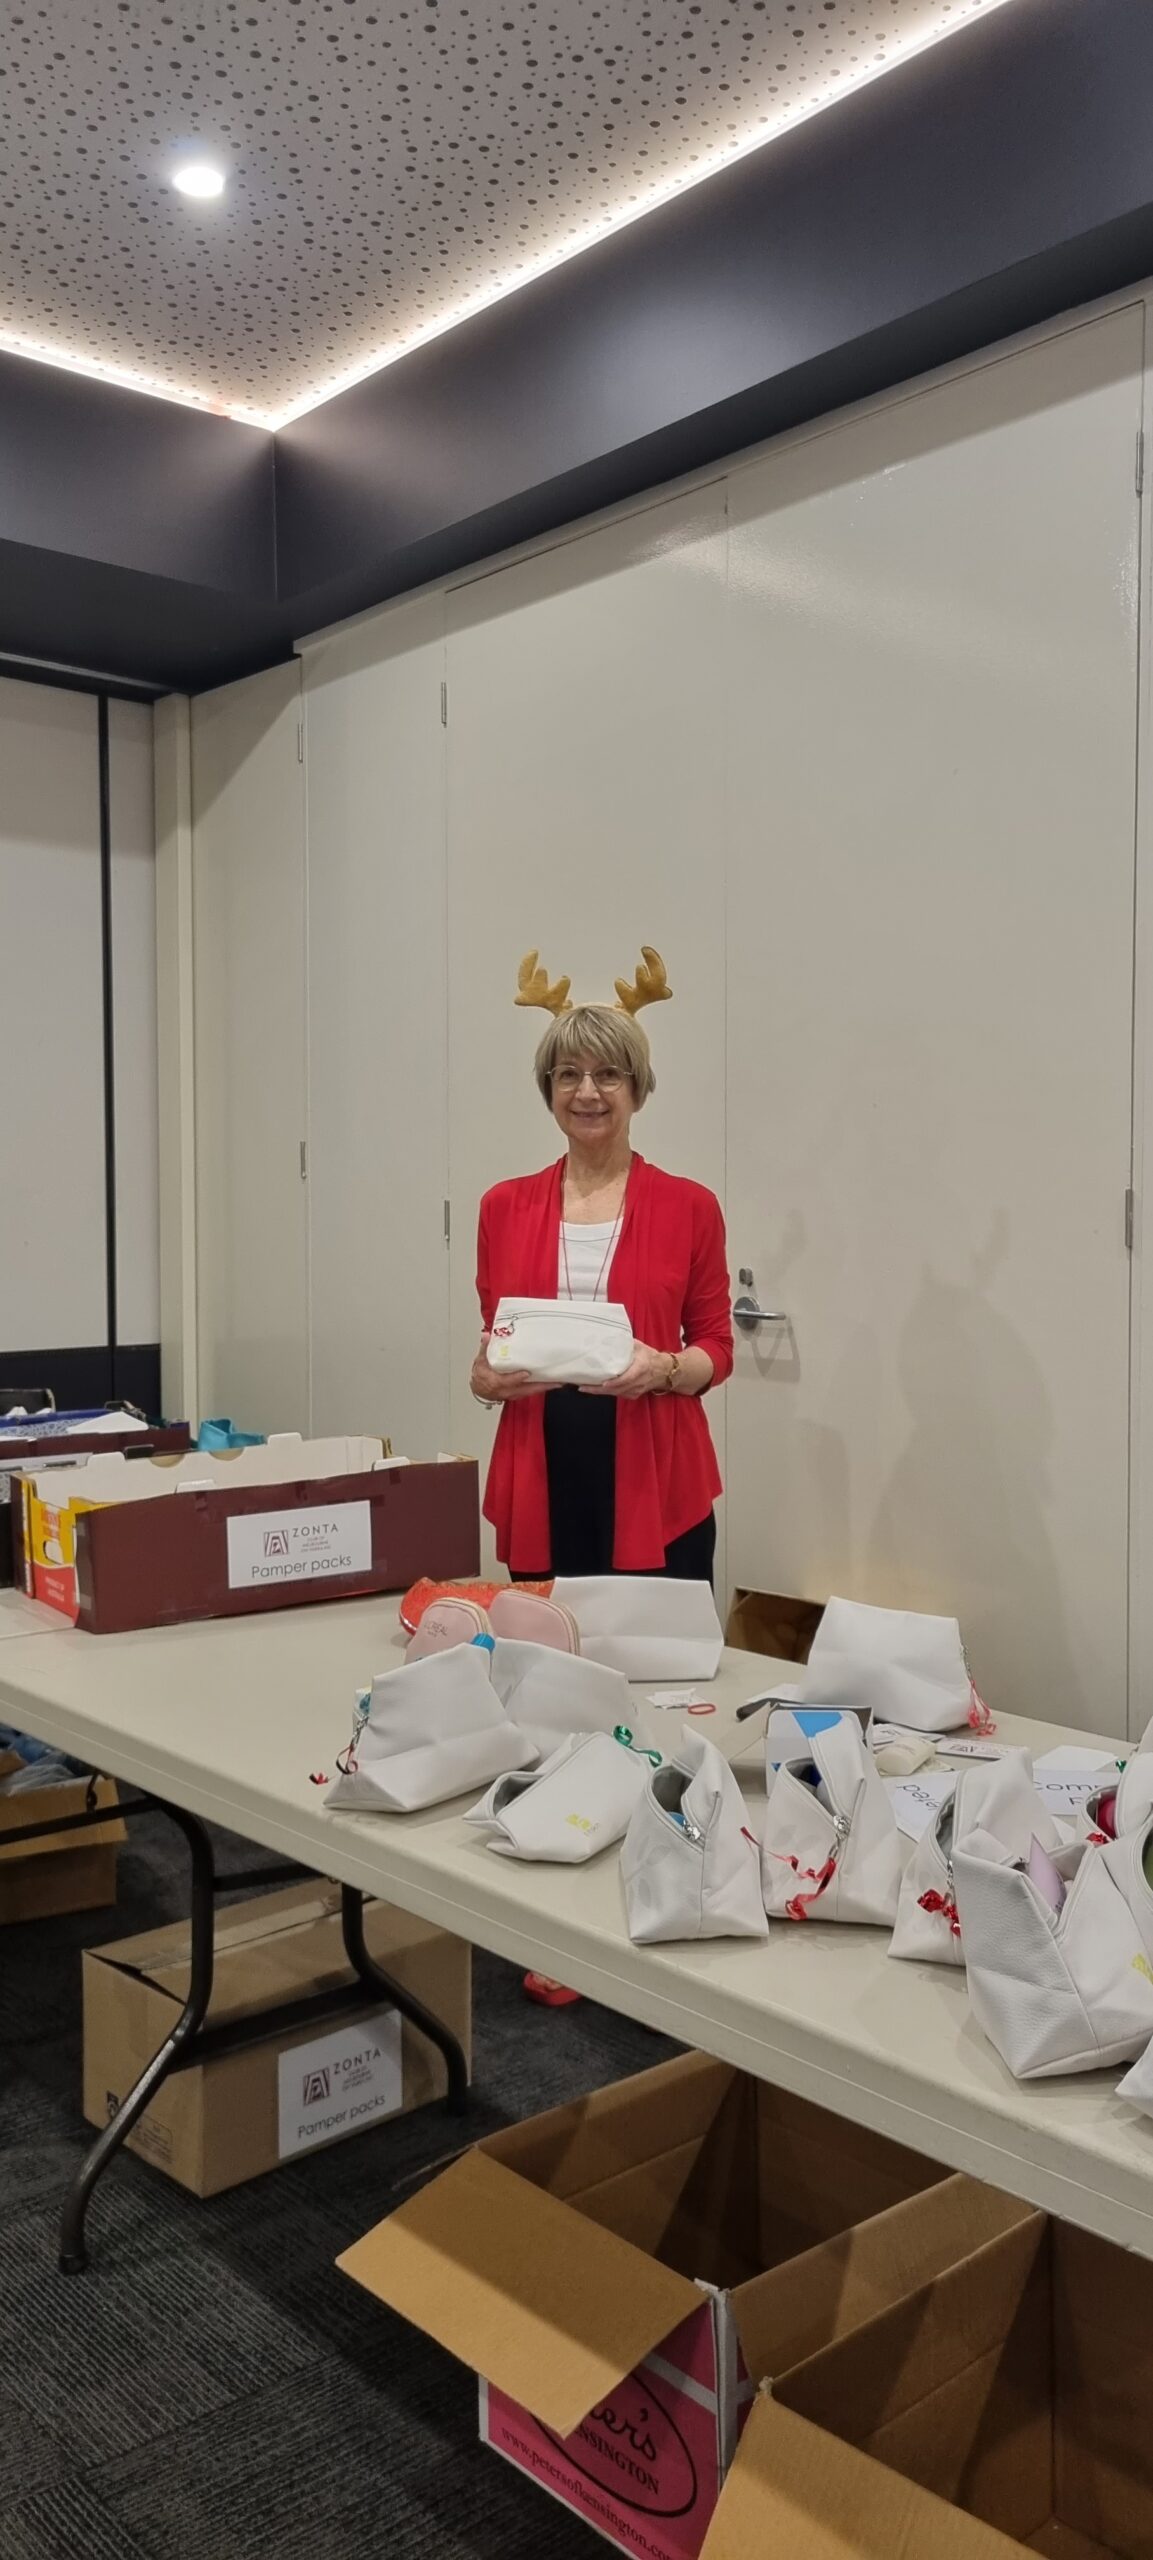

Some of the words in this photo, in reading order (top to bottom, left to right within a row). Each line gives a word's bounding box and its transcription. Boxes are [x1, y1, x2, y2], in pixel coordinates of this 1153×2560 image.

[292, 1523, 339, 1538] ZONTA
[251, 1561, 308, 1579] Pamper
[310, 1554, 352, 1574] packs
[333, 2048, 381, 2075] ZONTA
[297, 2110, 347, 2139] Pamper
[349, 2095, 386, 2119] packs
[574, 2423, 660, 2495] NSINGTON
